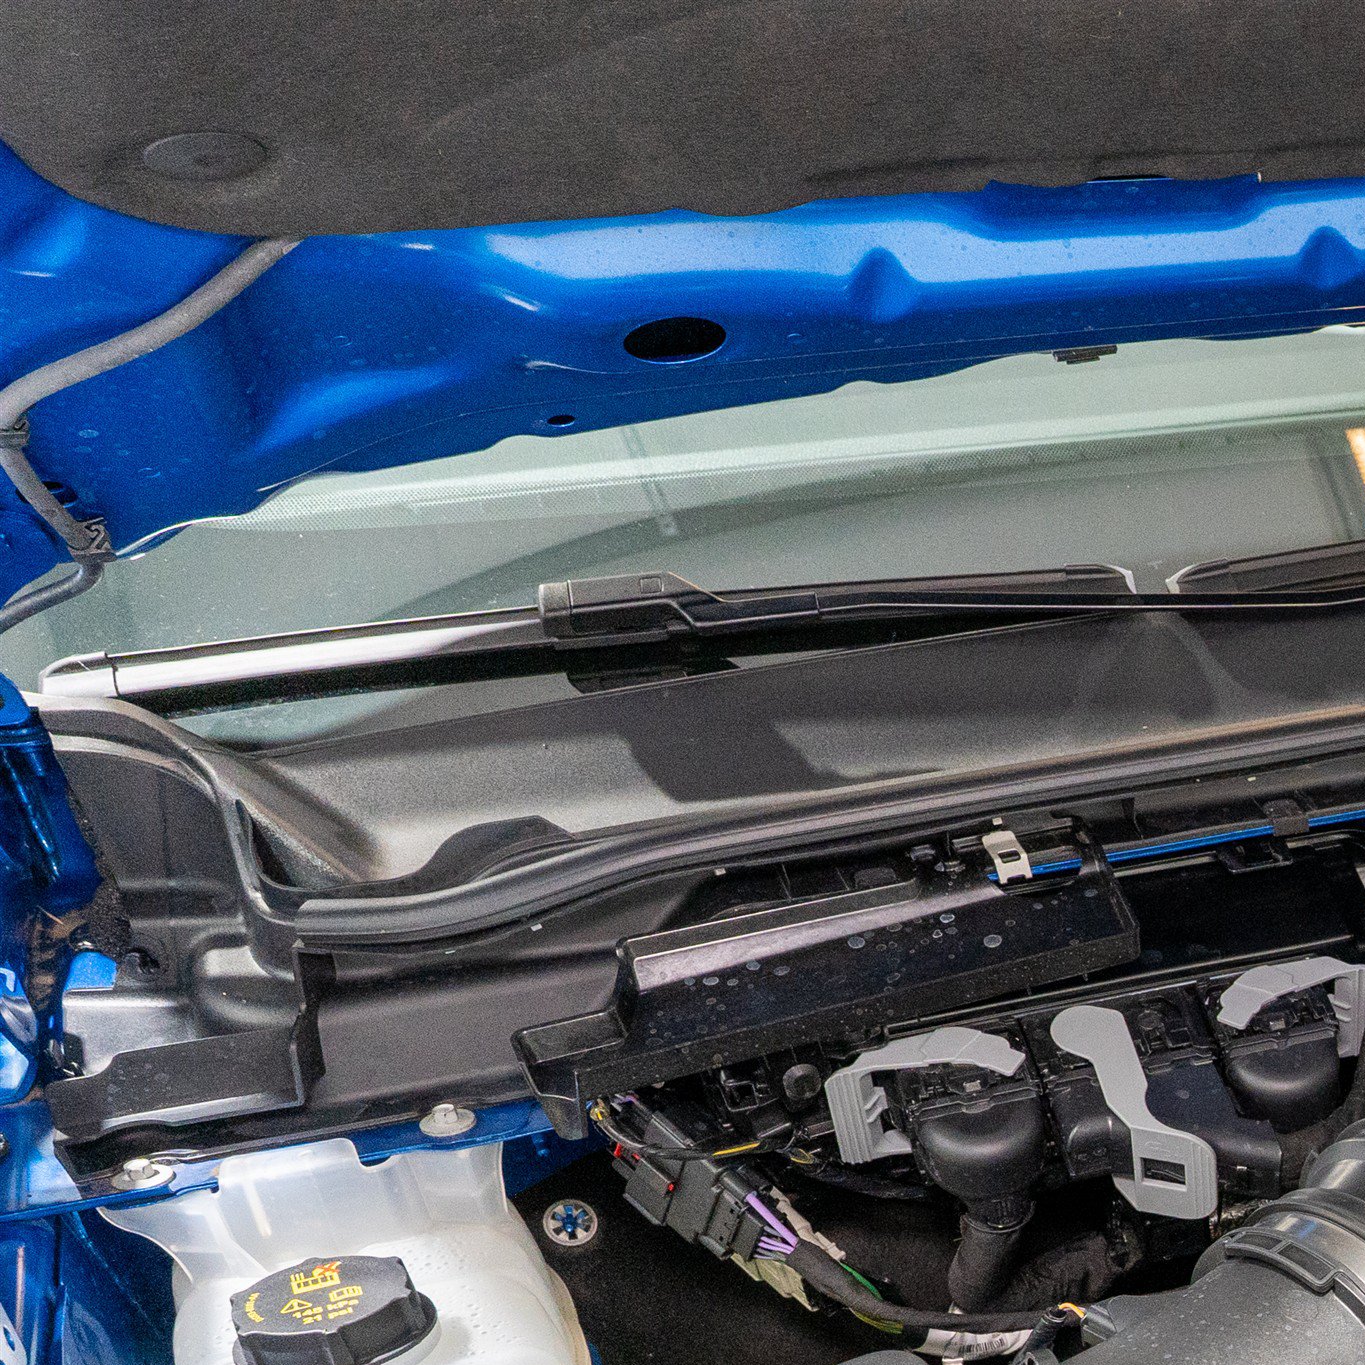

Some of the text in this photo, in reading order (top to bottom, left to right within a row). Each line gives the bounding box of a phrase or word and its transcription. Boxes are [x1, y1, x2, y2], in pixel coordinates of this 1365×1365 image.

[327, 1299, 360, 1310] kPa
[303, 1307, 353, 1325] 21 psi
